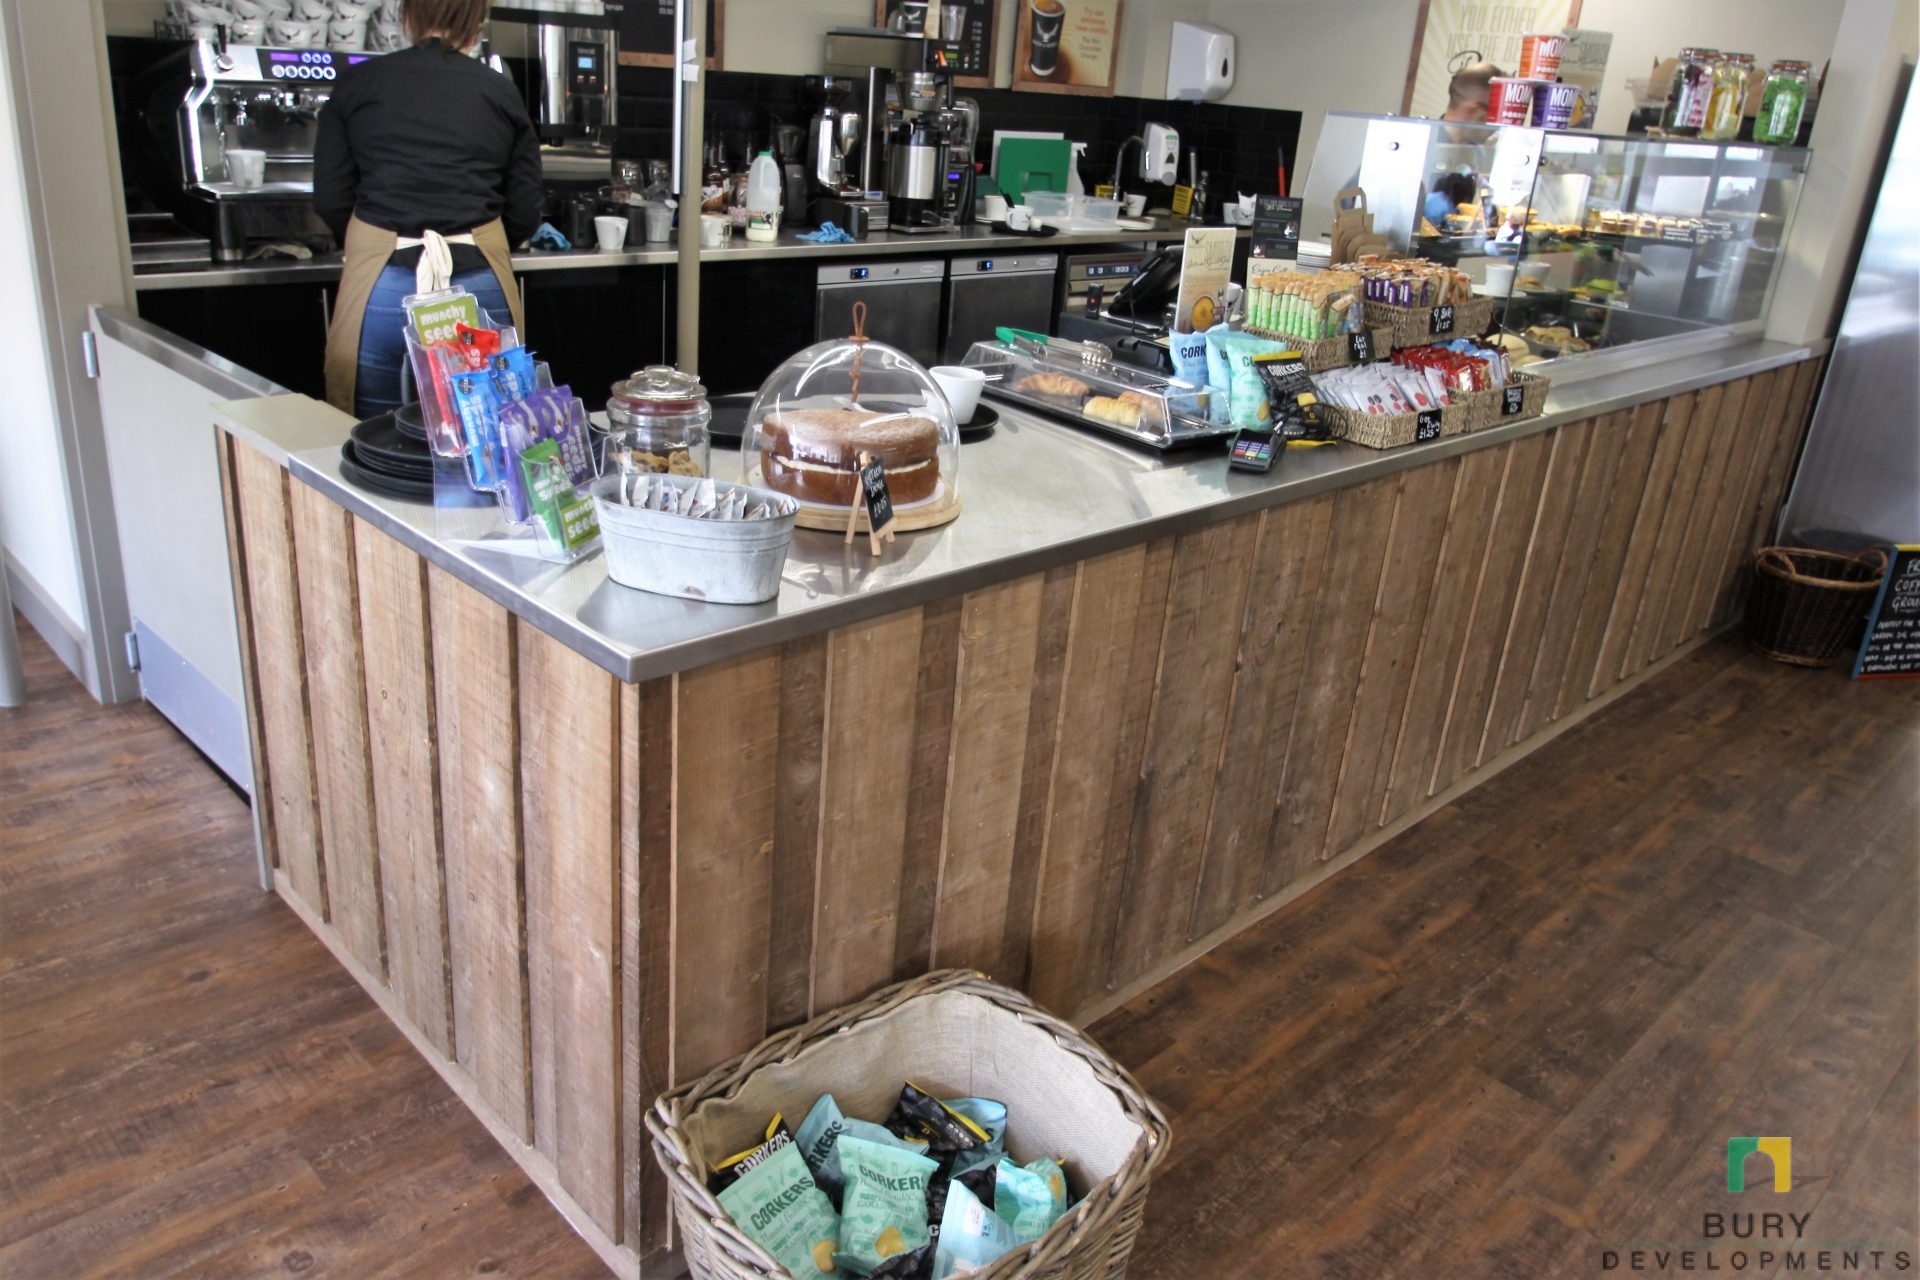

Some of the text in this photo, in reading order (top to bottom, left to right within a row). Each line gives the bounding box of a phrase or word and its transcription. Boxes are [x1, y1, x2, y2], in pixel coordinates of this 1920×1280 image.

[1460, 5, 1537, 34] YOU EITHER
[1477, 34, 1501, 61] THE
[420, 305, 466, 326] munchy
[733, 1129, 790, 1177] CORKERS
[750, 1176, 815, 1231] CORKERS
